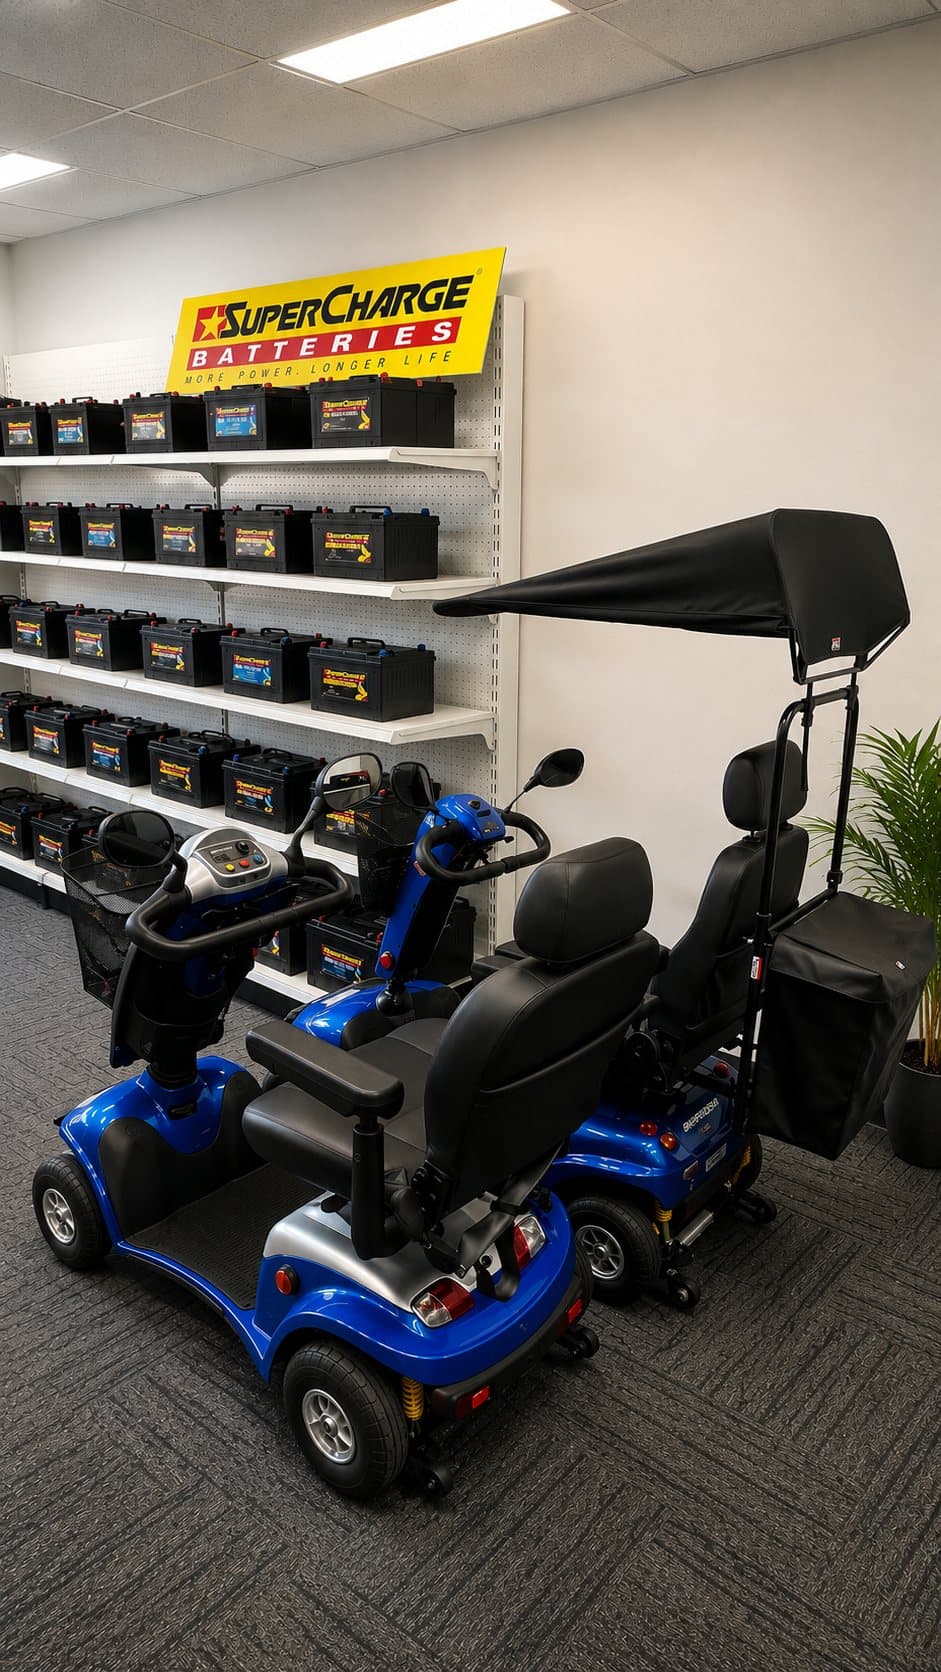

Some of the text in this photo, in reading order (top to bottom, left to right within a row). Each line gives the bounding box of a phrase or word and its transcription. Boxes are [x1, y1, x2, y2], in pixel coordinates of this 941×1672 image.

[219, 274, 474, 339] SUPERCHARGE
[185, 350, 452, 385] MORE POWER. LONGER LIFE
[191, 321, 453, 368] BATTERIES
